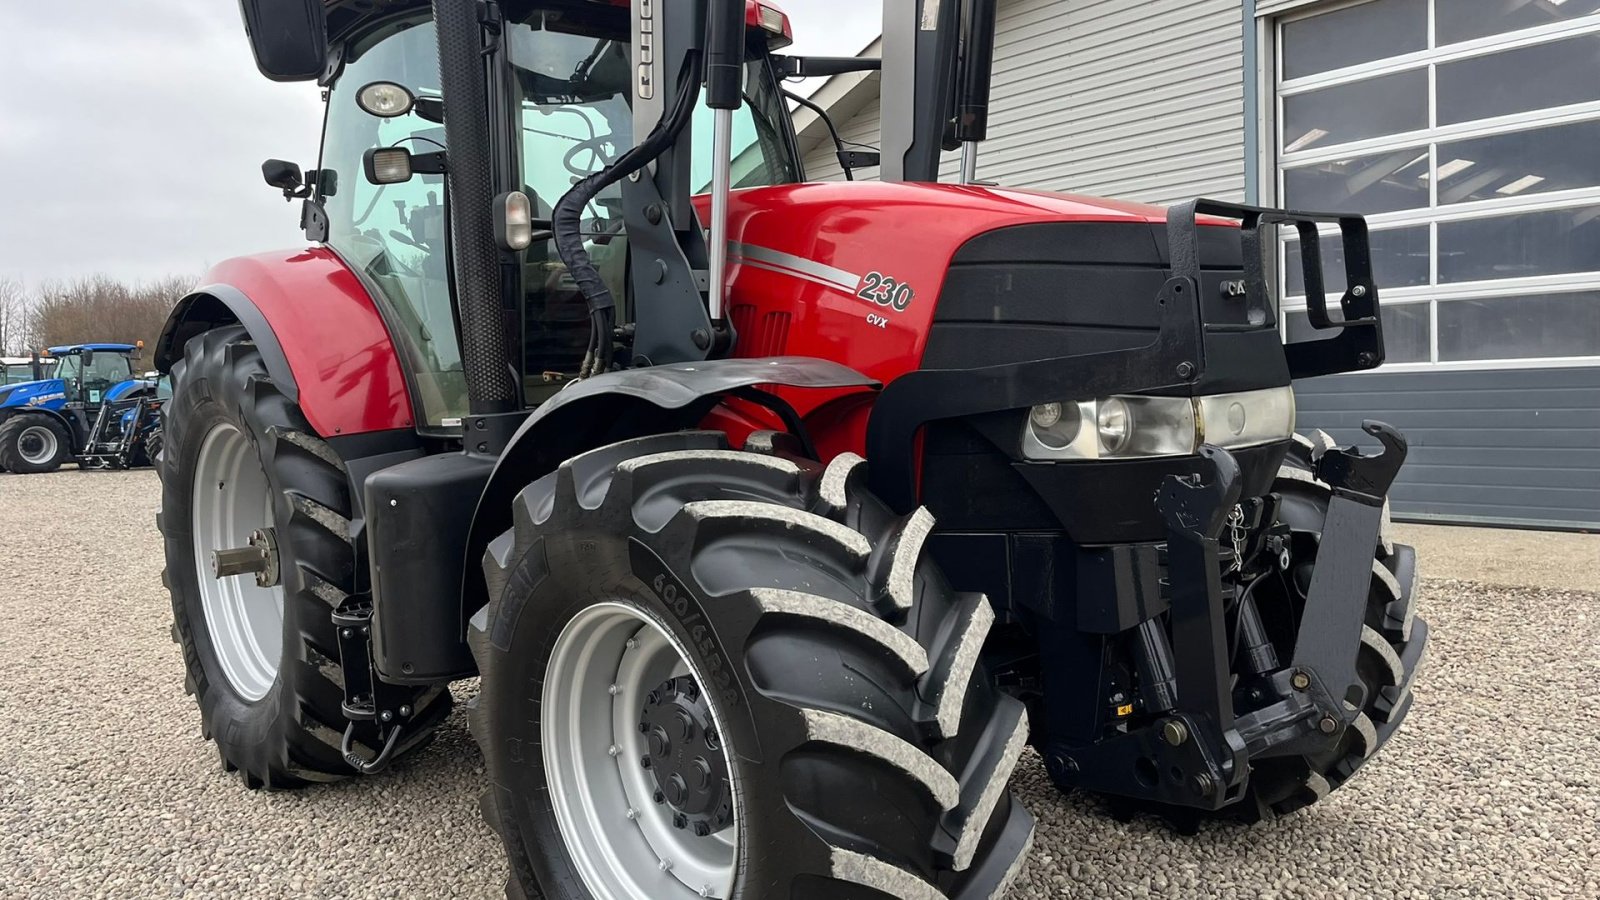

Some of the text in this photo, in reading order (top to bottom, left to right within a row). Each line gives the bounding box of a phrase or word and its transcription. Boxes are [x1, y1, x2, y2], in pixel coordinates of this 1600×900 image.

[857, 271, 913, 312] 230
[1228, 279, 1246, 295] CA
[866, 313, 889, 329] CVX
